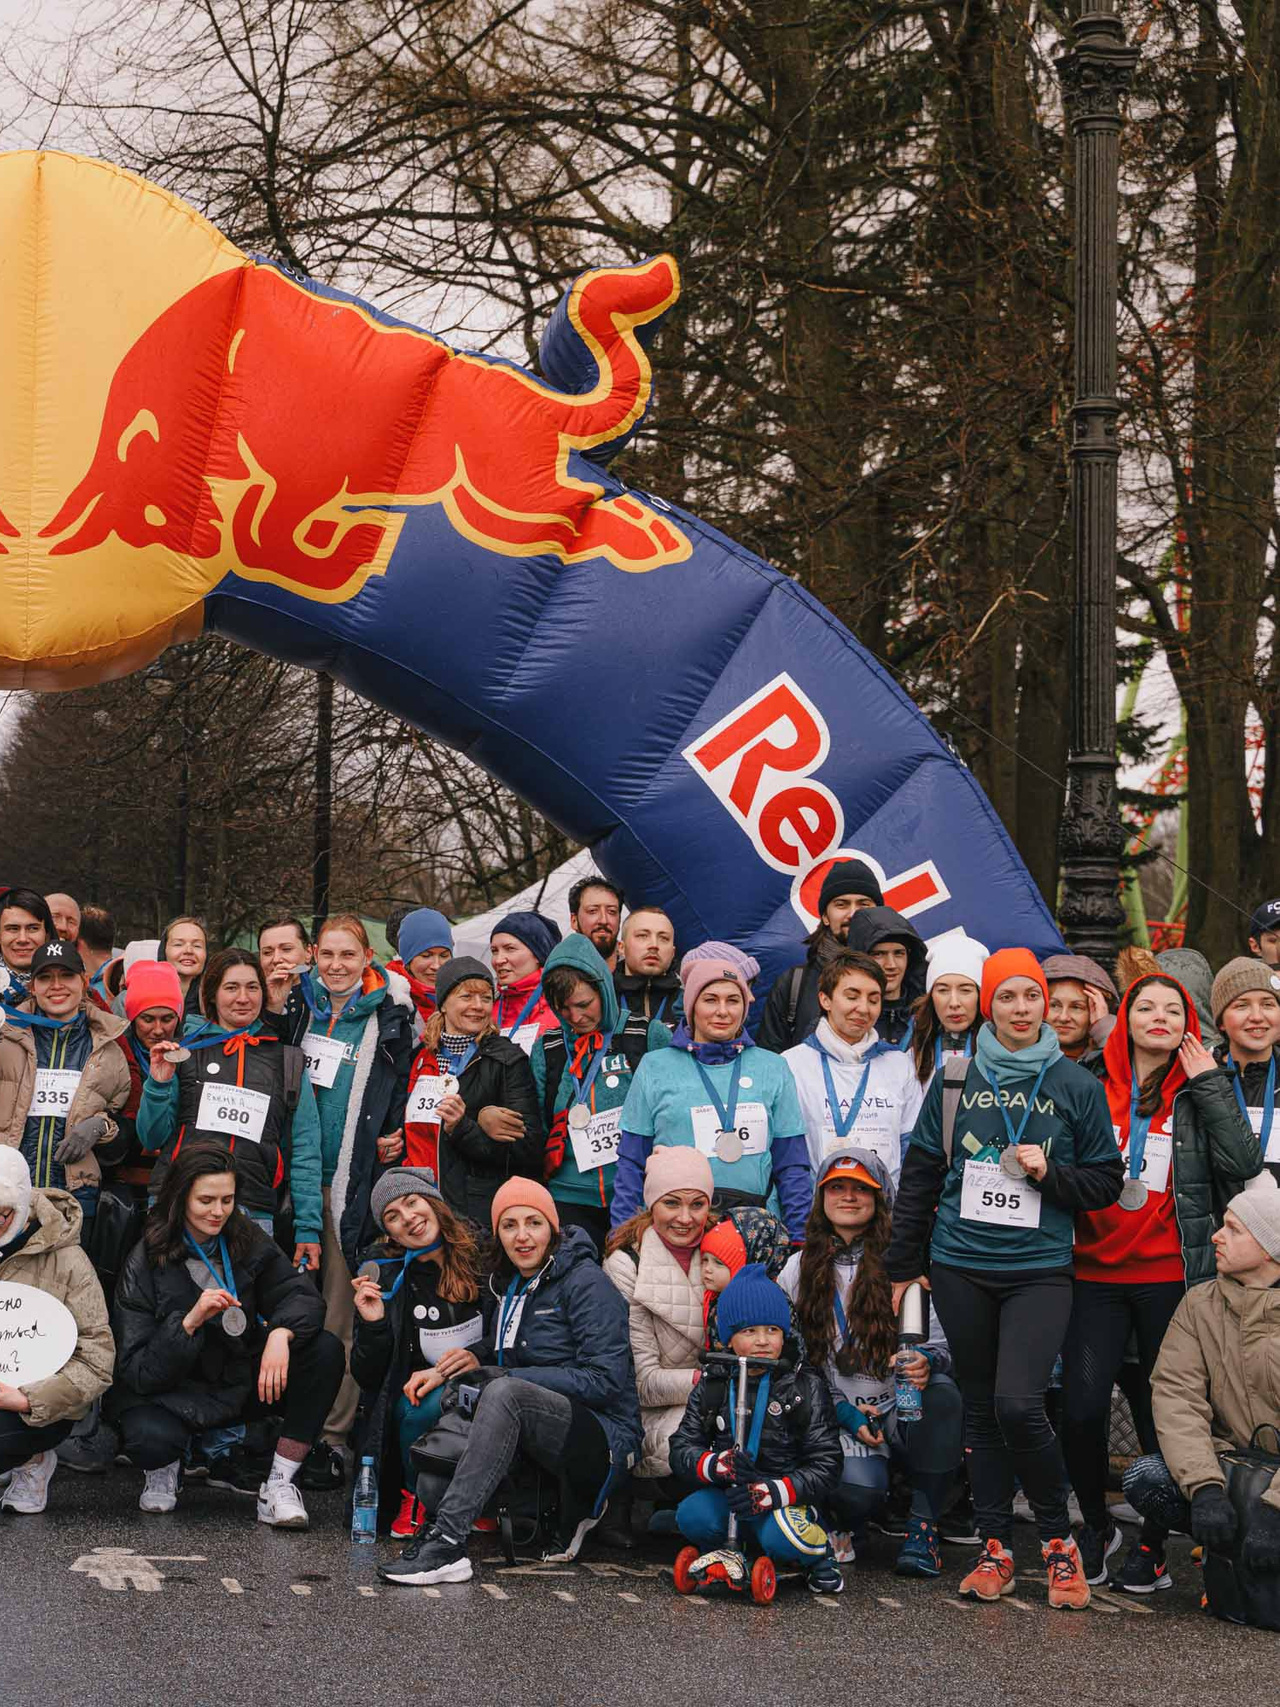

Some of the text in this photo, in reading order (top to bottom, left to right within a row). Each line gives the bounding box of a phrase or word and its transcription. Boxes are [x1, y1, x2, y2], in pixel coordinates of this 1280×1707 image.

[36, 1090, 70, 1105] 335
[216, 1106, 250, 1125] 680
[981, 1190, 1021, 1210] 595
